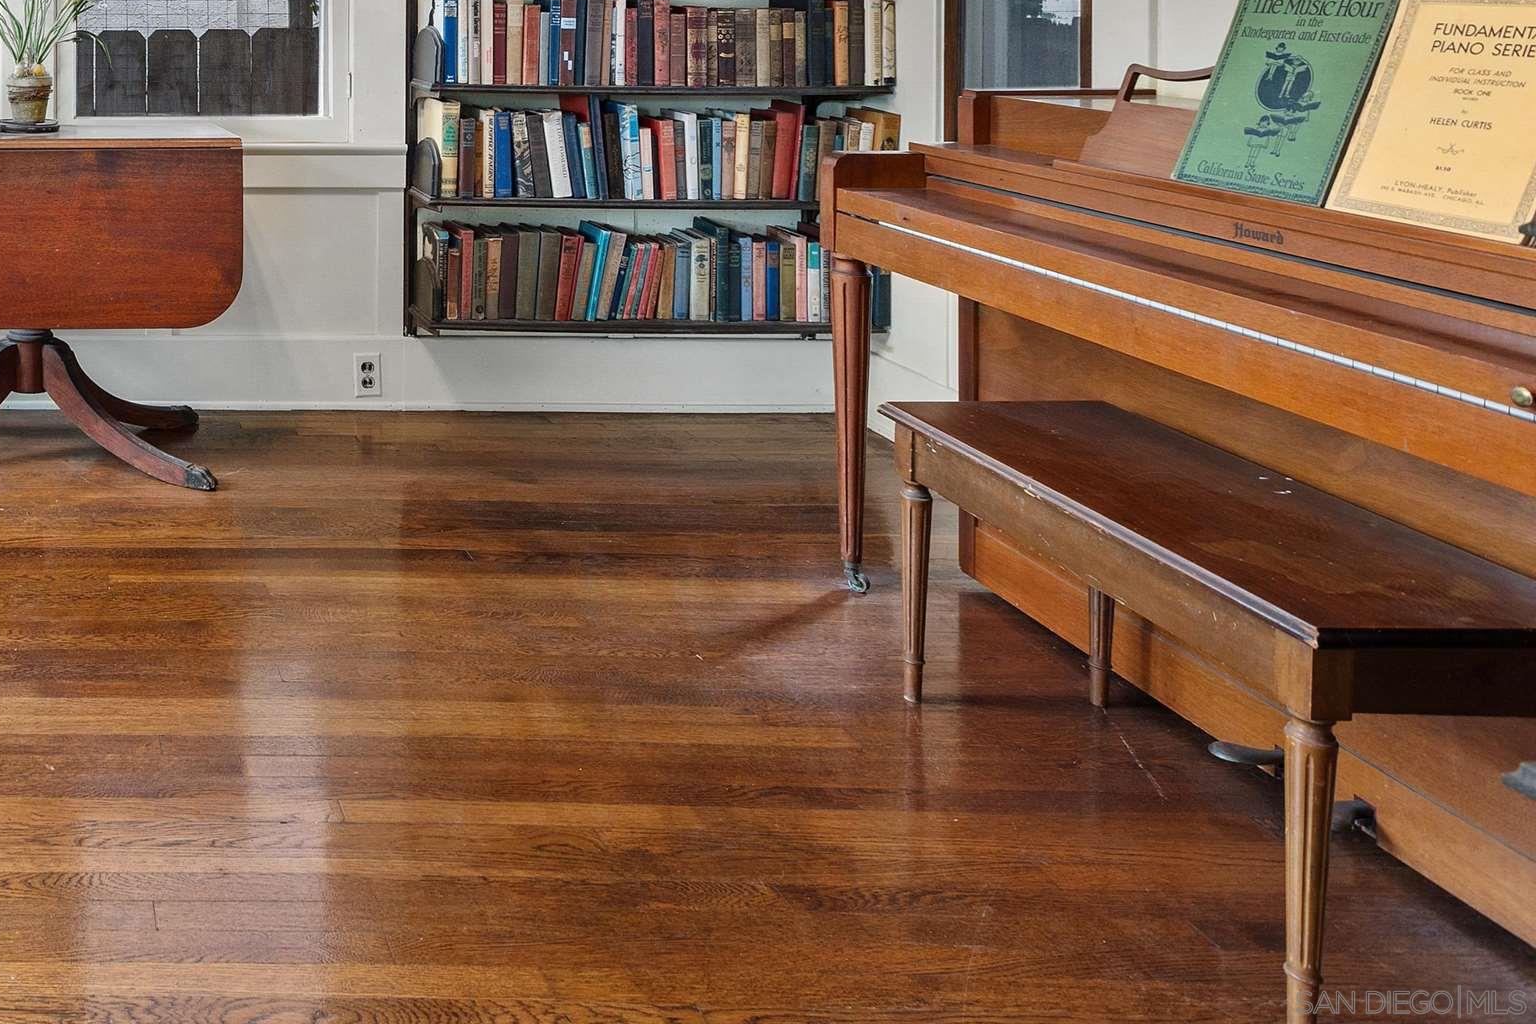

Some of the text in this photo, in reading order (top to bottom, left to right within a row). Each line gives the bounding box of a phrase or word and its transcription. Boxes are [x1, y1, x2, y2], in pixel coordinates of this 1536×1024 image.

[1296, 16, 1324, 28] in the
[1240, 26, 1372, 44] Kindergarten and First Grade
[1430, 40, 1484, 55] PIANO
[1449, 66, 1512, 78] FOR CLASS AND
[1429, 75, 1526, 88] INDIVIDUAL INSTRUCTION
[1453, 88, 1492, 97] BOOK ONE
[1429, 117, 1493, 130] HELEN CURTIS
[1197, 160, 1305, 191] California State Series
[1233, 222, 1284, 245] Howard
